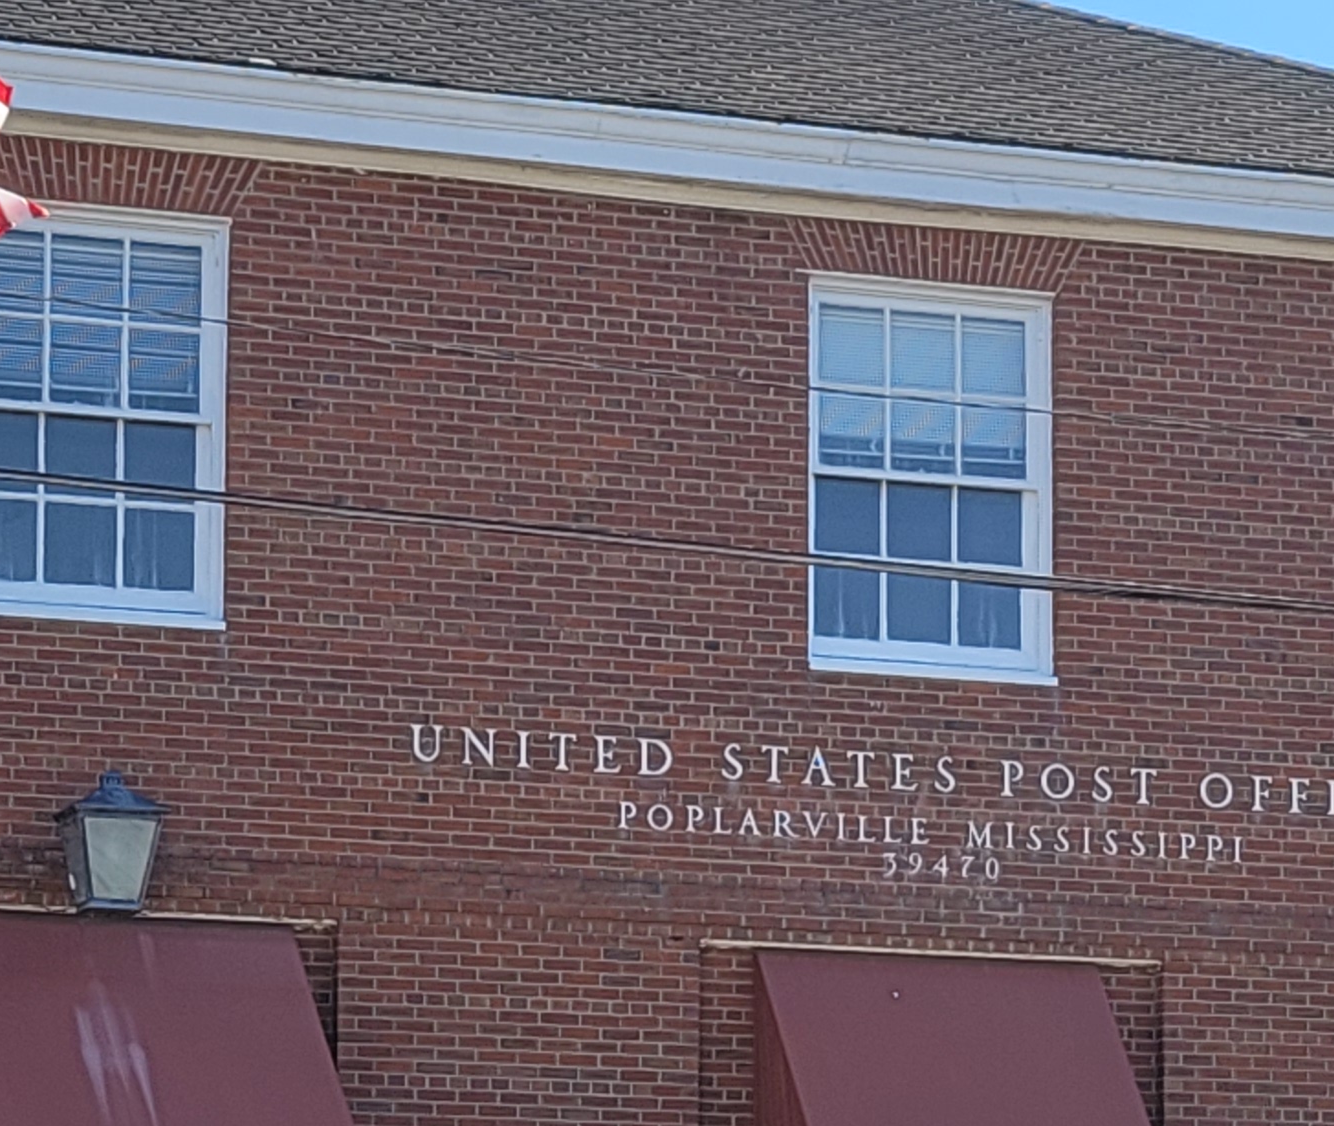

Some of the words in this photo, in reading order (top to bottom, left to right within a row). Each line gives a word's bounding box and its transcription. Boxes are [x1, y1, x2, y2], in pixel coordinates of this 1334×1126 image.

[410, 722, 673, 776] UNITED
[721, 743, 956, 793] STATES
[1000, 759, 1158, 806] POST
[617, 800, 931, 846] POPLARVILLE
[967, 820, 1244, 864] MISSISSIPPI
[882, 852, 1000, 881] 39470
